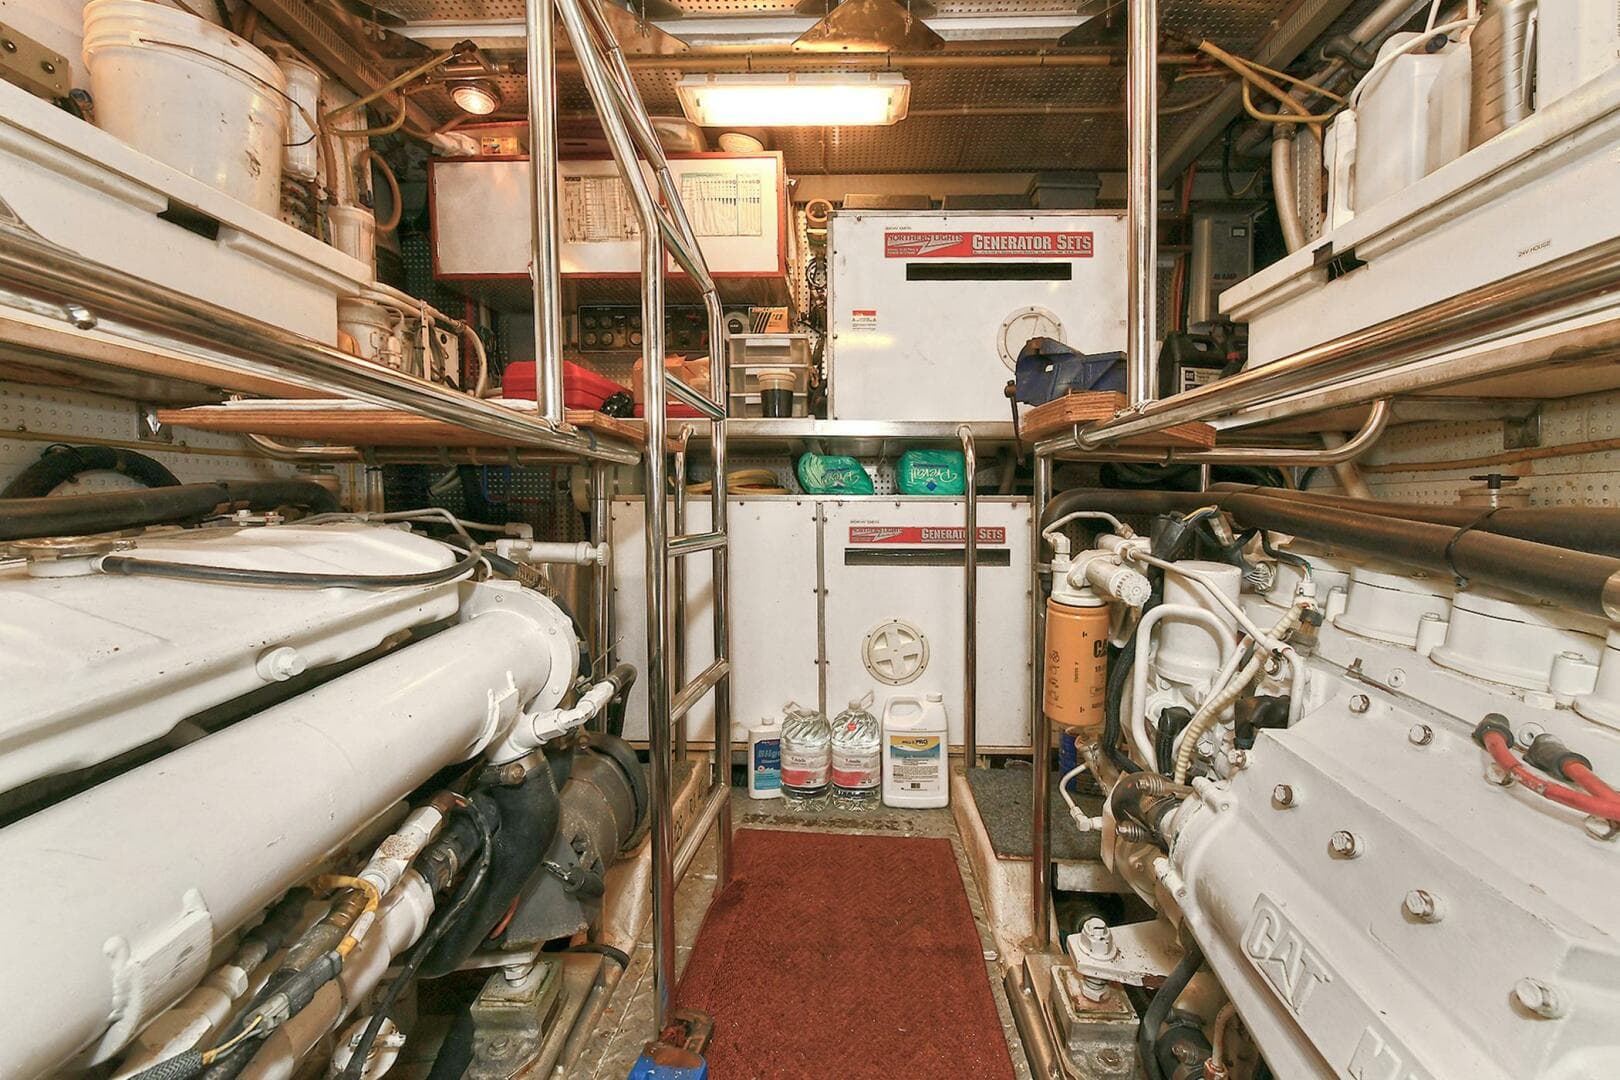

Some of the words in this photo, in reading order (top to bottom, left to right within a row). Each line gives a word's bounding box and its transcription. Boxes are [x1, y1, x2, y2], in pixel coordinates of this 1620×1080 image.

[972, 234, 1052, 250] GENERATOR
[1056, 234, 1092, 250] SETS
[910, 463, 957, 483] Prevail
[921, 529, 966, 540] GENERAT
[979, 529, 1004, 540] SETS
[1250, 907, 1333, 1017] CAT
